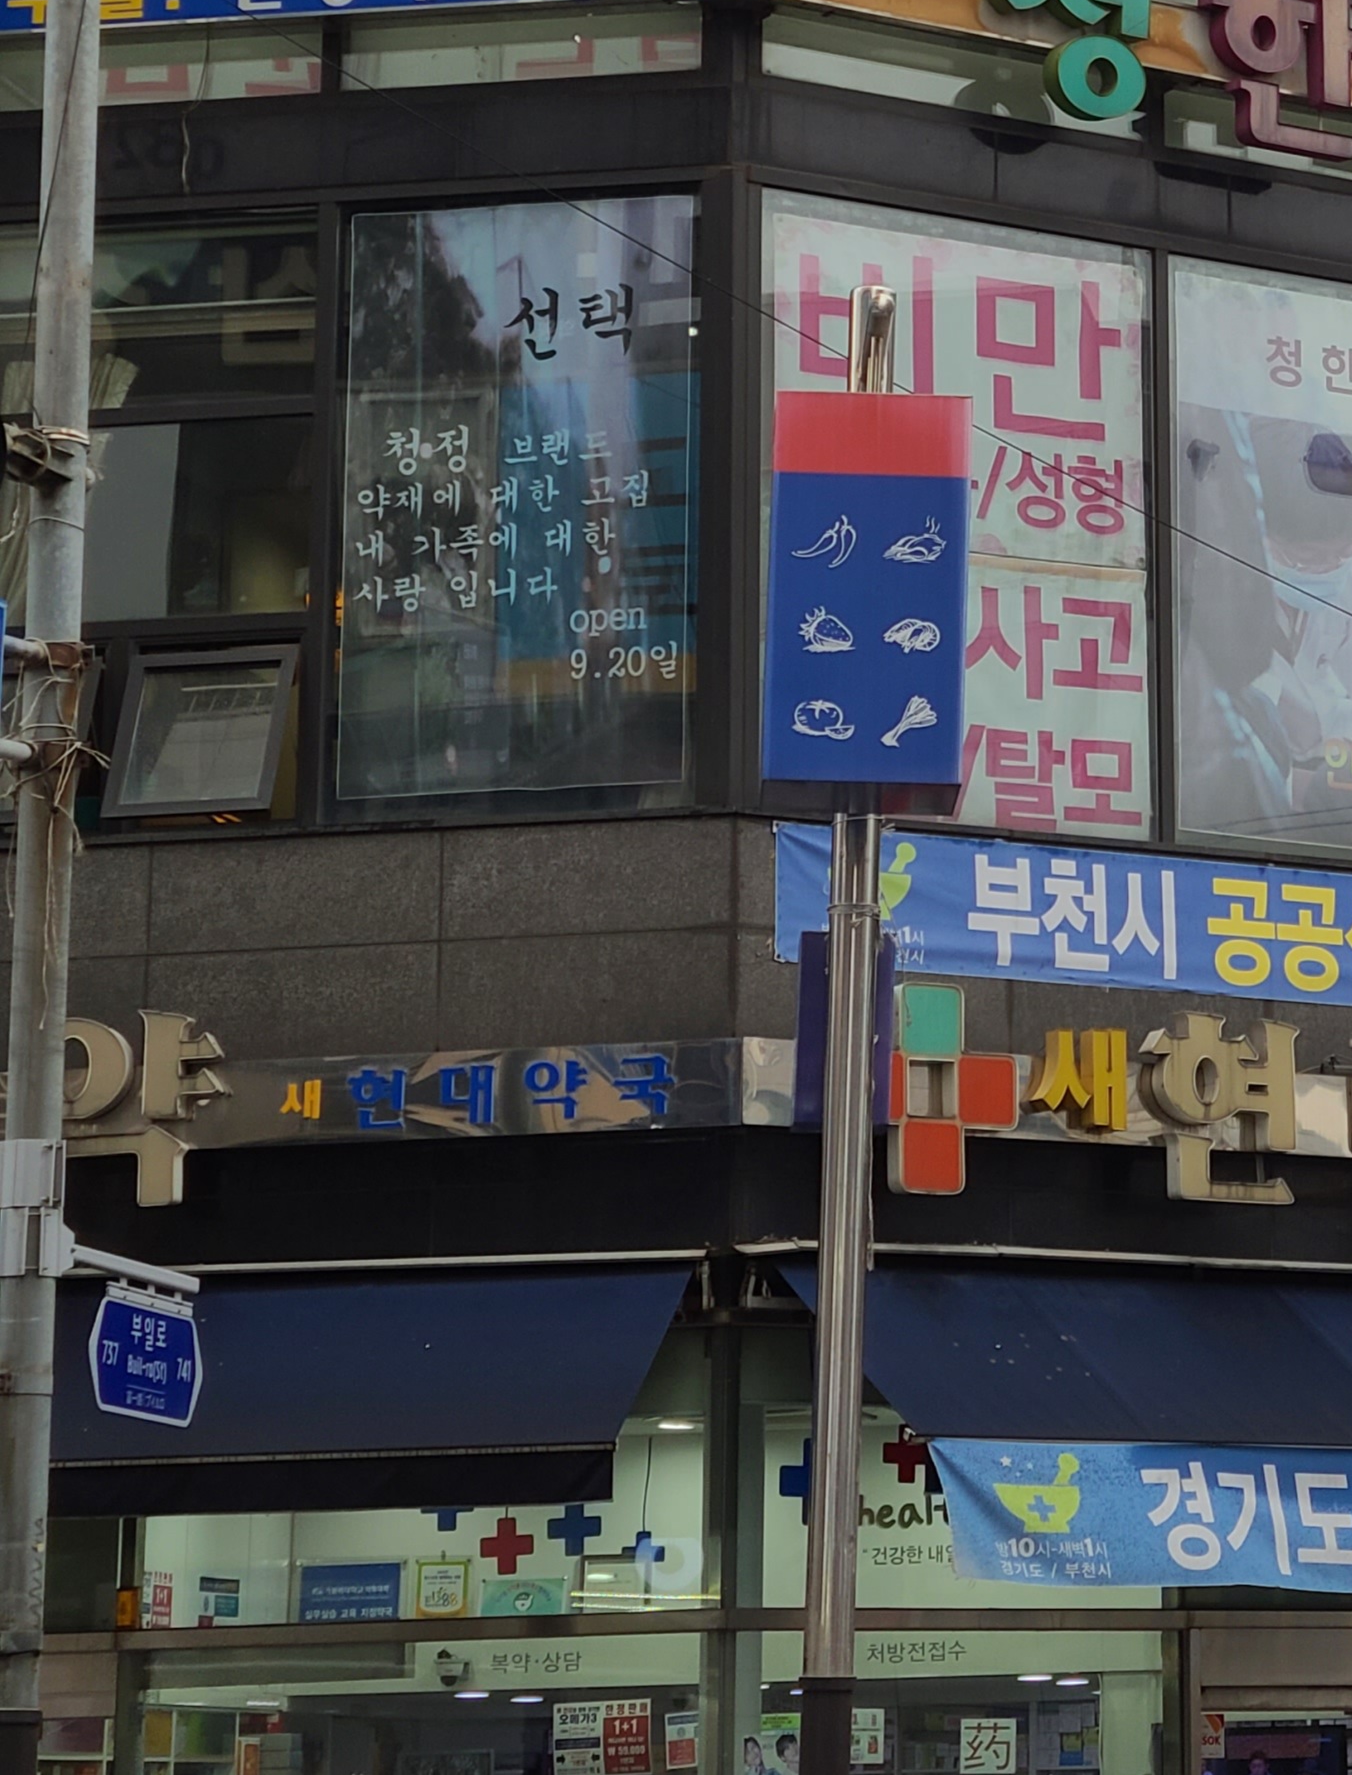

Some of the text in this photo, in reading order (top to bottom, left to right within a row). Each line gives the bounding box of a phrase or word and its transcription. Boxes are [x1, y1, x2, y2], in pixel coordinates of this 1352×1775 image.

[503, 283, 635, 361] 선택
[1265, 335, 1302, 388] 청
[504, 430, 613, 467] 브랜드
[357, 469, 650, 523] 약재에 대한 고집
[355, 517, 617, 567] 내 가족에 대한
[352, 566, 559, 613] 사랑 입니다
[569, 607, 648, 638] open
[569, 639, 679, 681] 9.20일
[967, 853, 1178, 981] 부천시
[130, 1313, 167, 1352] 부일로
[102, 1339, 119, 1365] 737
[176, 1357, 192, 1382] 741
[858, 1494, 950, 1529] healt
[1000, 1560, 1044, 1578] 경기도
[1064, 1561, 1112, 1579] 부천시
[866, 1641, 968, 1664] 처방전접수
[559, 1712, 598, 1725] 오메가3
[605, 1702, 648, 1716] 한정판매
[613, 1718, 638, 1736] 1+1
[963, 1723, 1012, 1770] 药
